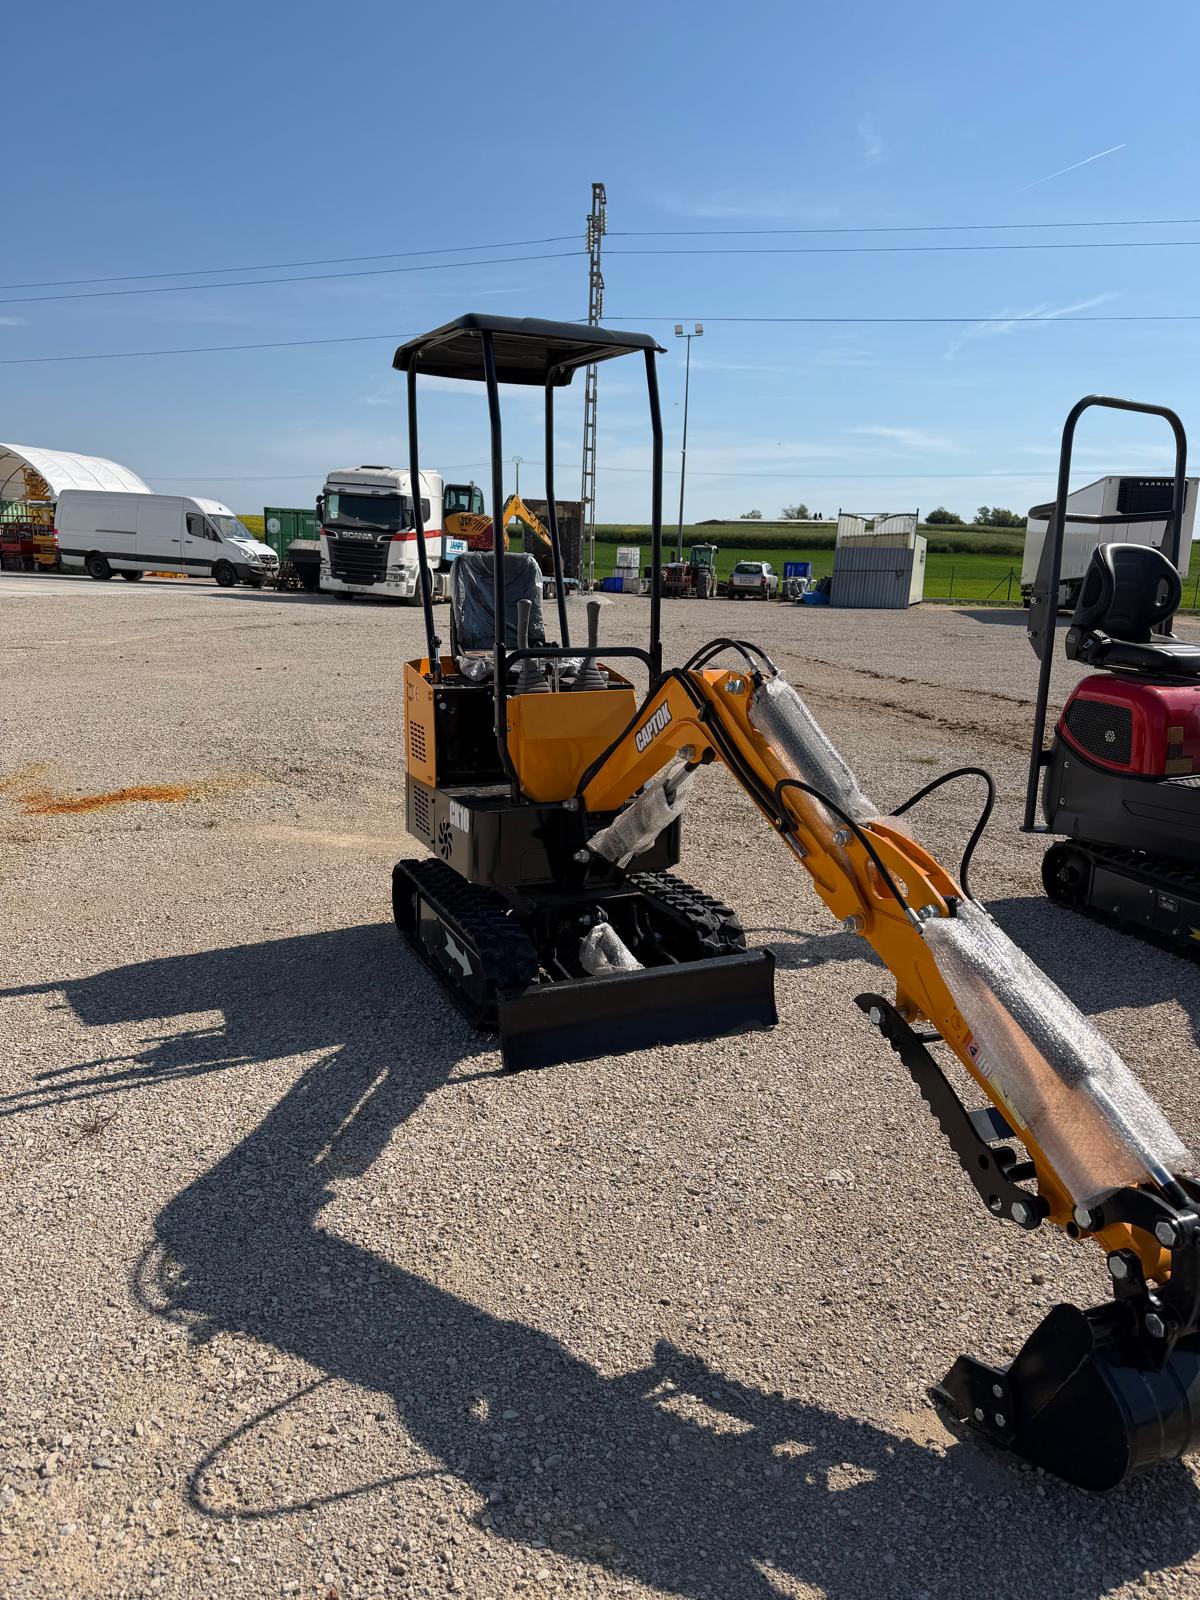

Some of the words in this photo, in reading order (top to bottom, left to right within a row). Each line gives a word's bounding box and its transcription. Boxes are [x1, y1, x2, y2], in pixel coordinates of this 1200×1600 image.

[342, 531, 373, 540] SCANIA
[635, 700, 672, 753] CAPTOK
[449, 800, 470, 833] CK10
